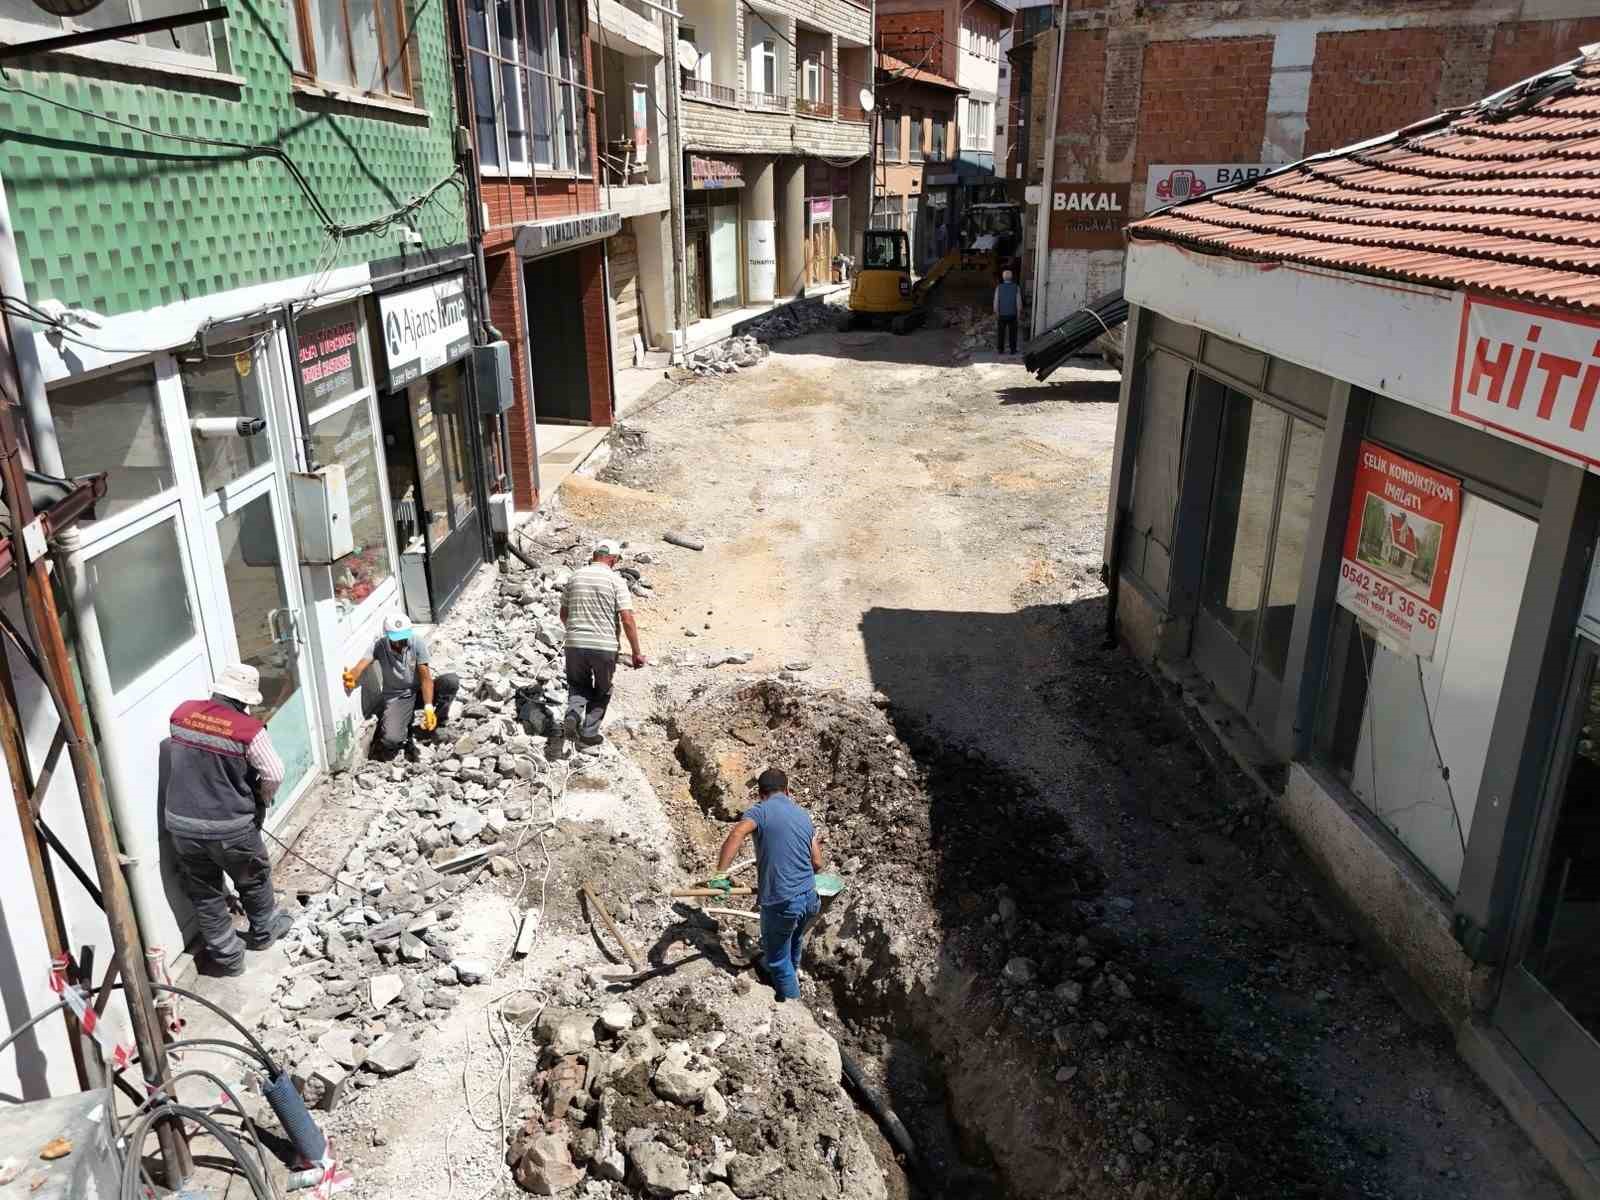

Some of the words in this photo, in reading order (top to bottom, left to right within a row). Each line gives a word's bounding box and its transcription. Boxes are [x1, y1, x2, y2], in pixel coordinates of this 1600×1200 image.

[1053, 191, 1122, 212] BAKAL
[404, 308, 438, 350] Ajans
[1364, 452, 1388, 473] ÇELİK
[1343, 564, 1370, 590] 0542
[1373, 582, 1393, 605] 581
[1400, 597, 1415, 617] 36
[1419, 608, 1437, 630] 56
